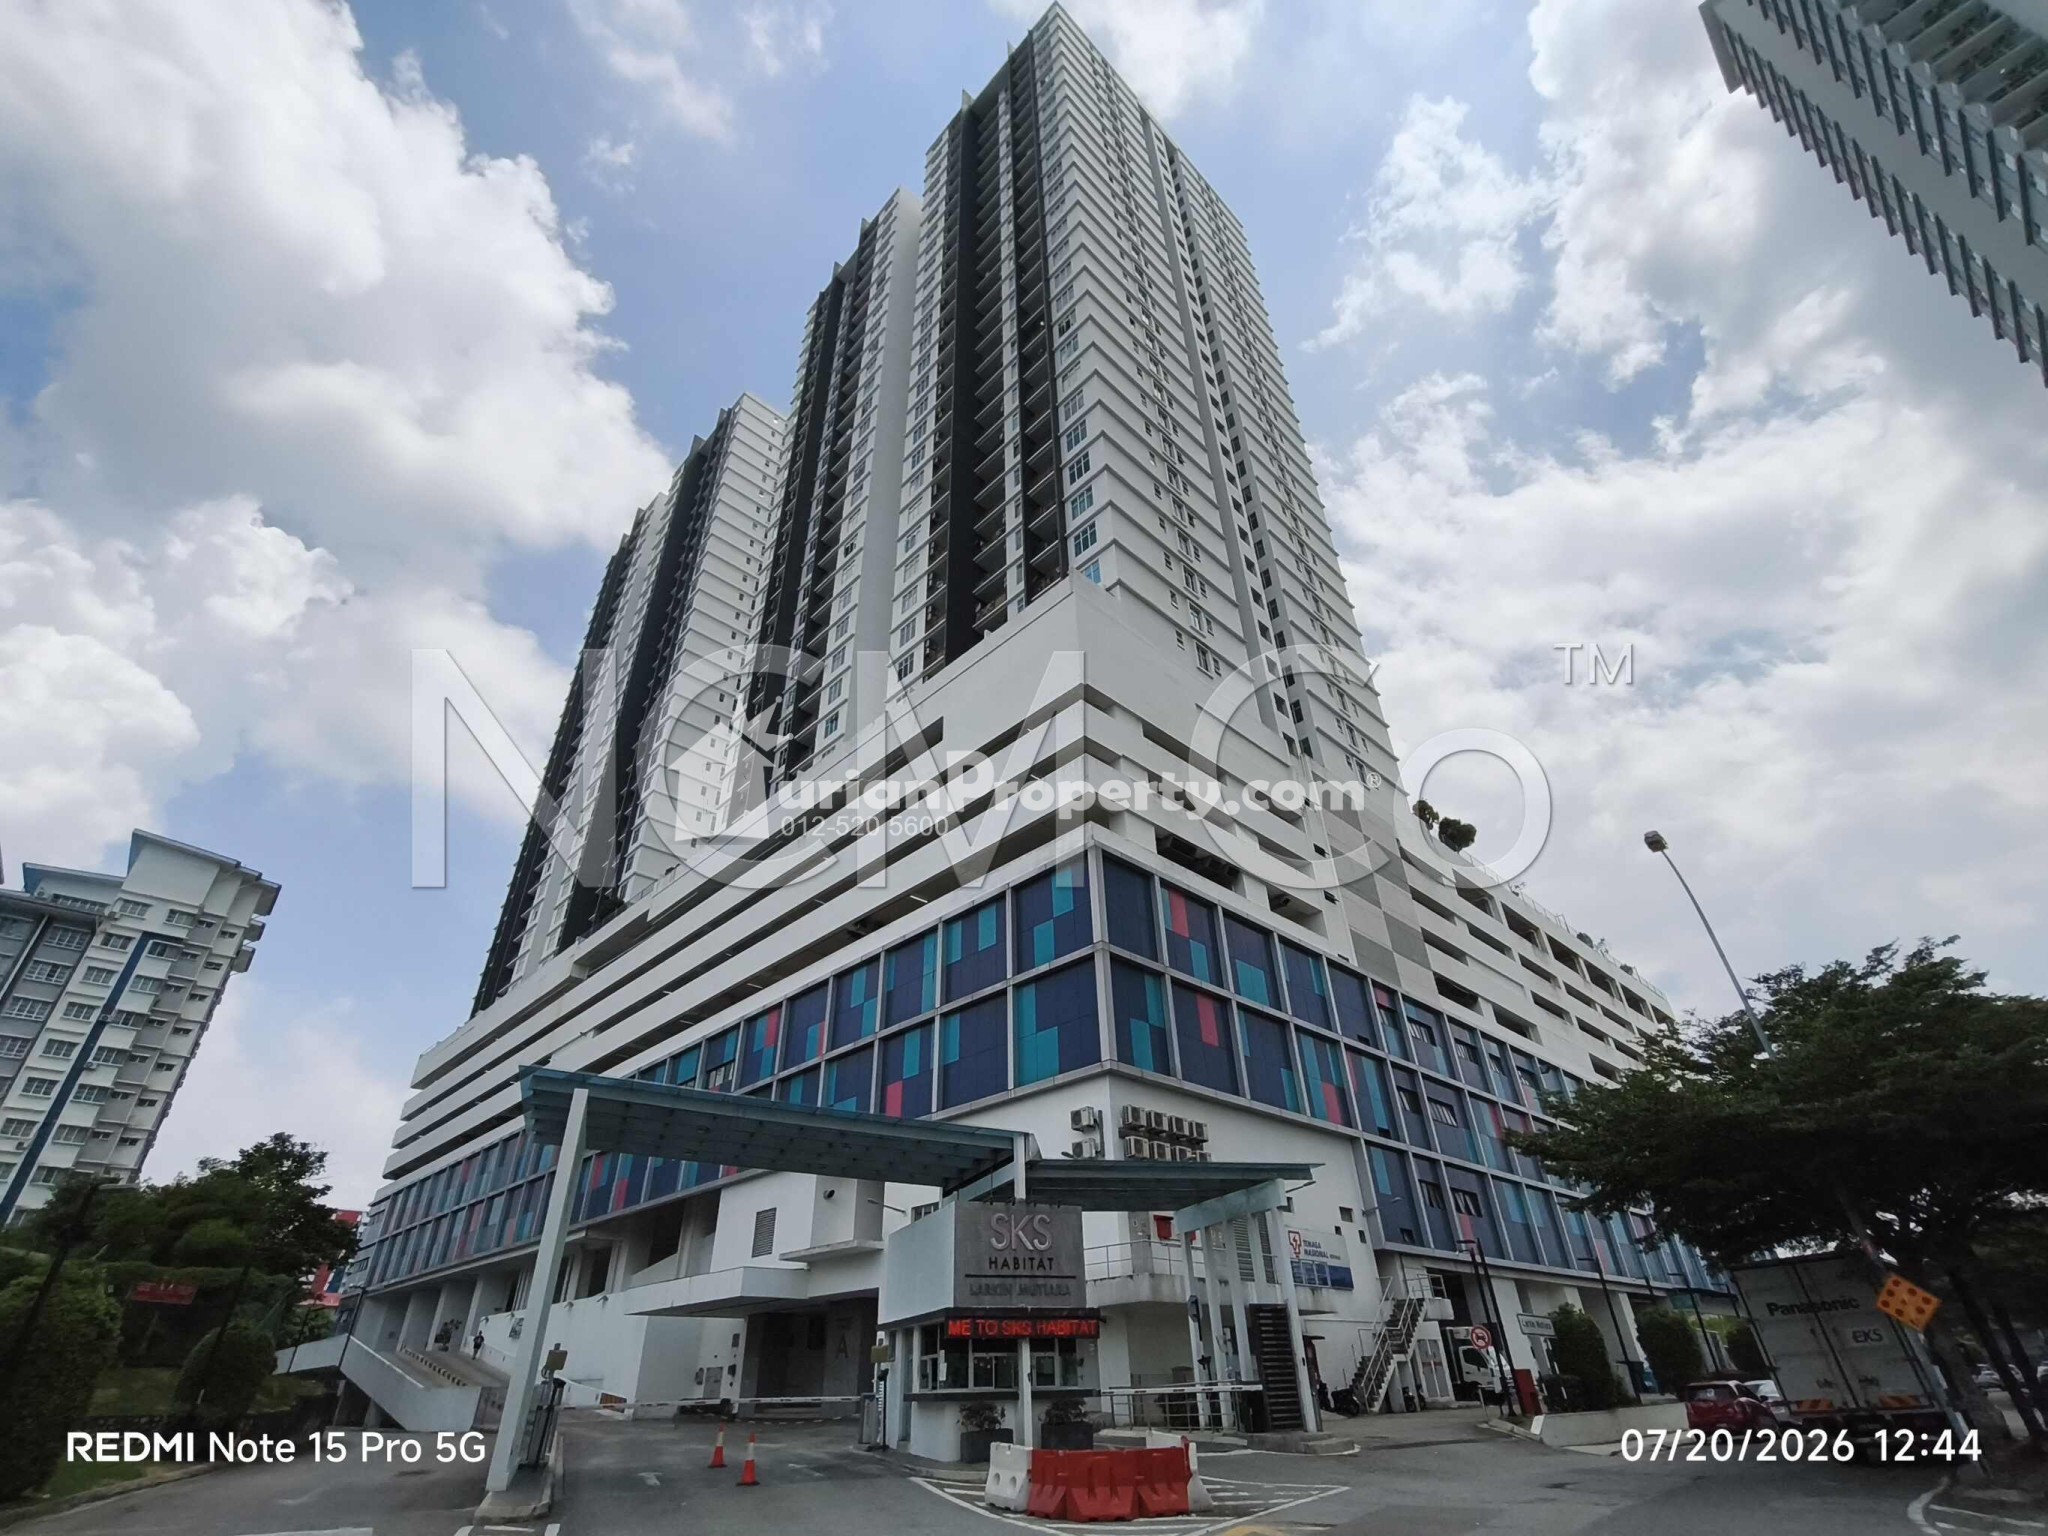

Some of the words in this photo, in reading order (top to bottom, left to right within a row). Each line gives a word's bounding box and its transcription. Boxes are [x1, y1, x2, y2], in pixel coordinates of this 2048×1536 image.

[989, 1212, 1051, 1251] SKS
[988, 1256, 1055, 1271] HABITAT
[1766, 1297, 1861, 1317] Panasonic
[948, 1319, 972, 1336] ME
[976, 1319, 998, 1336] TO
[1002, 1319, 1032, 1336] SKS
[1036, 1319, 1099, 1337] HABITAT
